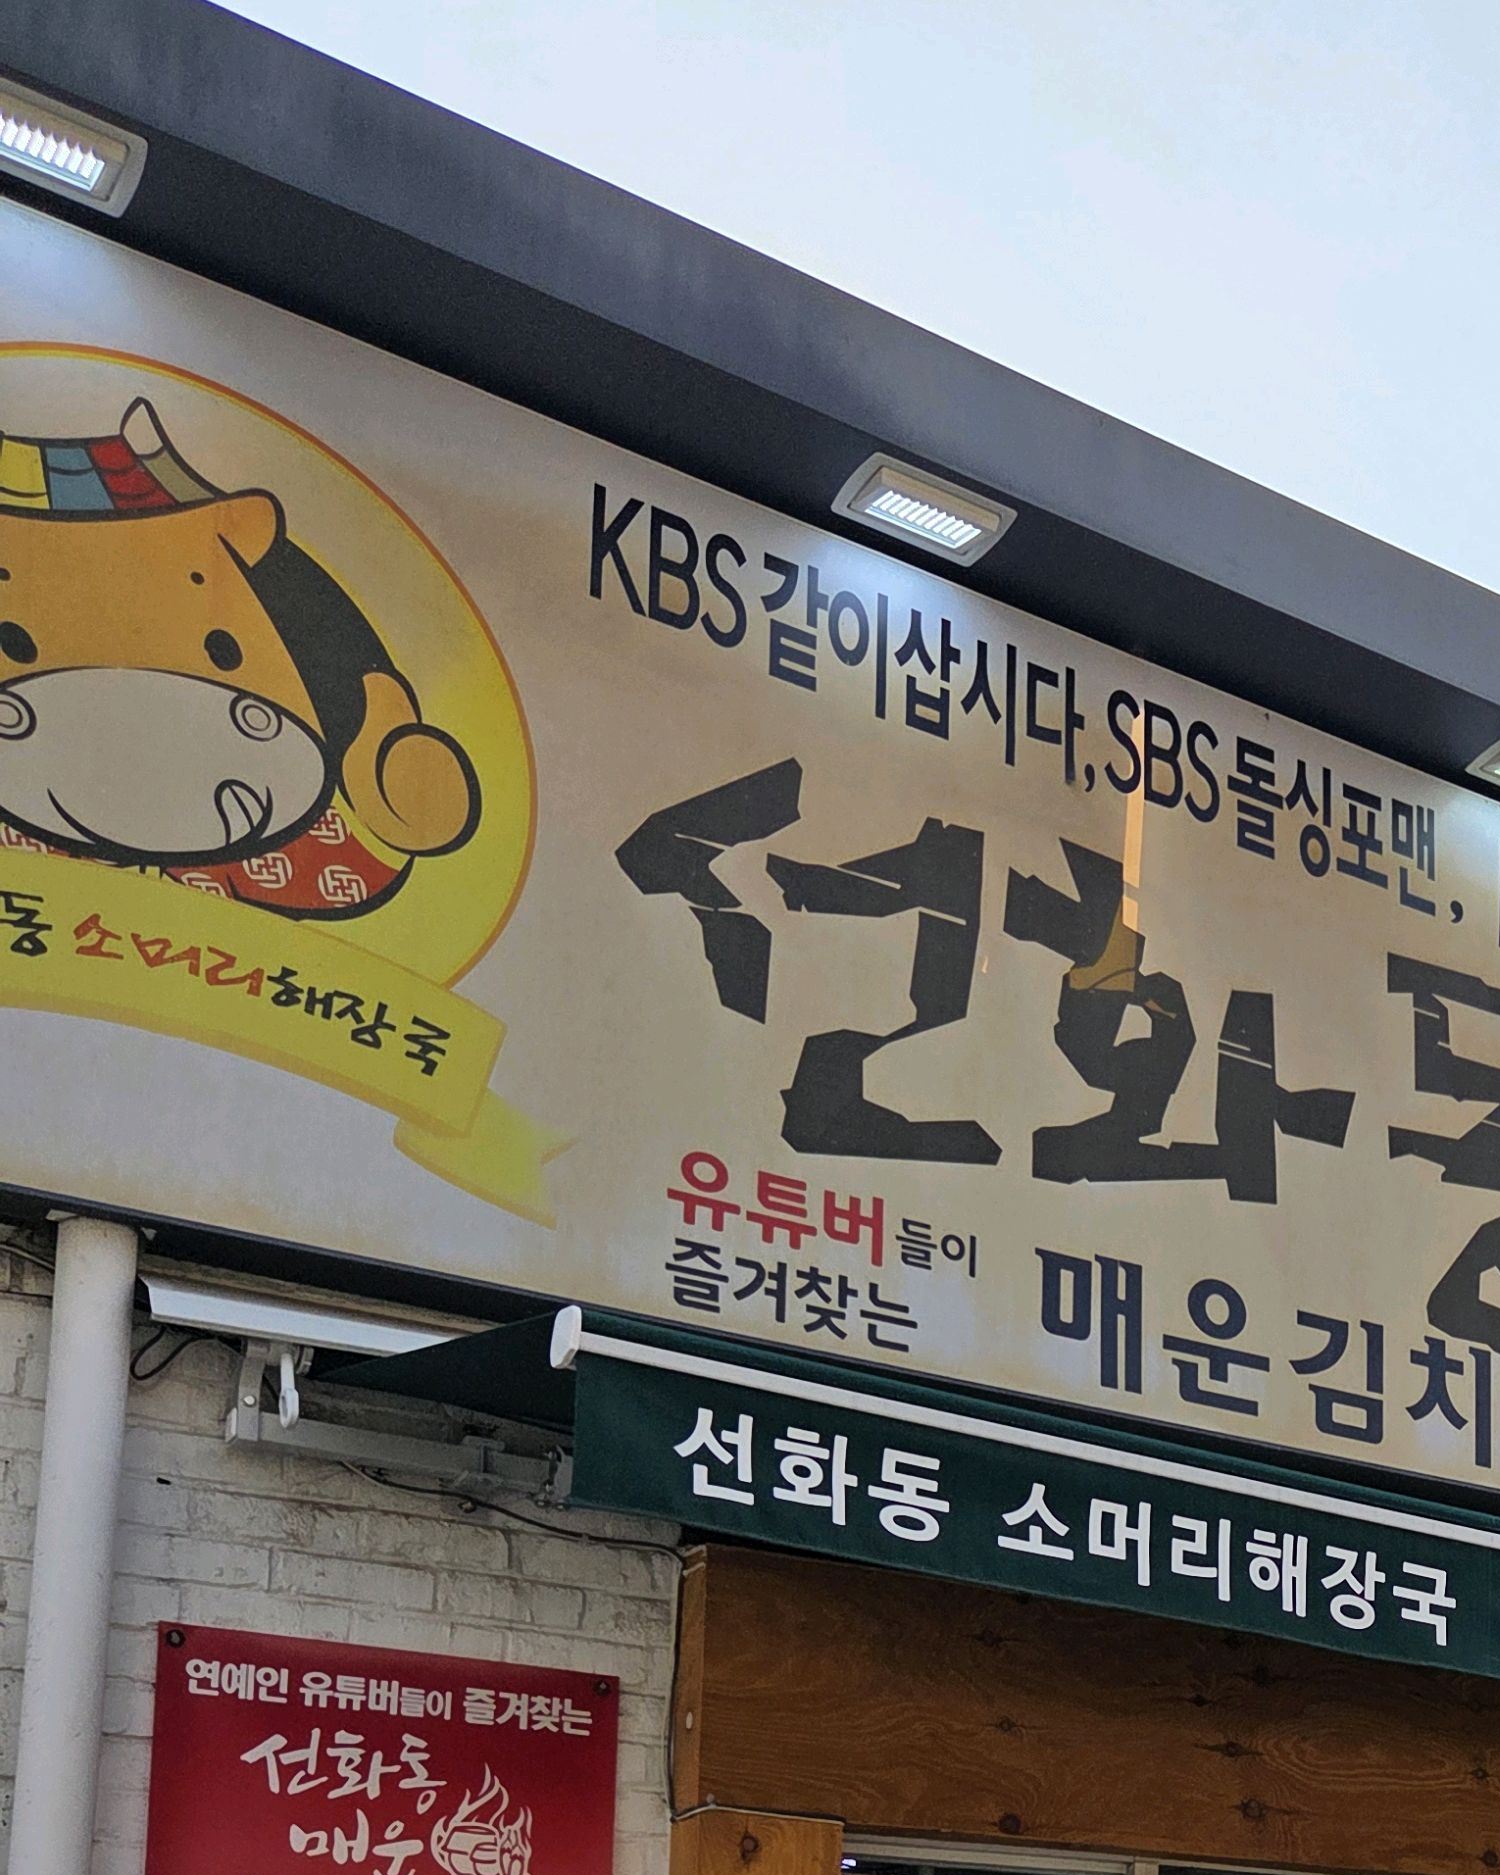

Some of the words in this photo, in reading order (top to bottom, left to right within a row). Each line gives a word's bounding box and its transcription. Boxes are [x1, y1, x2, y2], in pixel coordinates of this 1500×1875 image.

[664, 1237, 918, 1353] 즐겨찾는
[674, 1406, 951, 1542] 선화동
[997, 1482, 1457, 1648] 소머리해장국
[184, 1657, 289, 1705] 연예인
[300, 1671, 453, 1721] 유튜버들이
[462, 1686, 594, 1738] 즐겨찾는
[240, 1727, 448, 1815] 선화동
